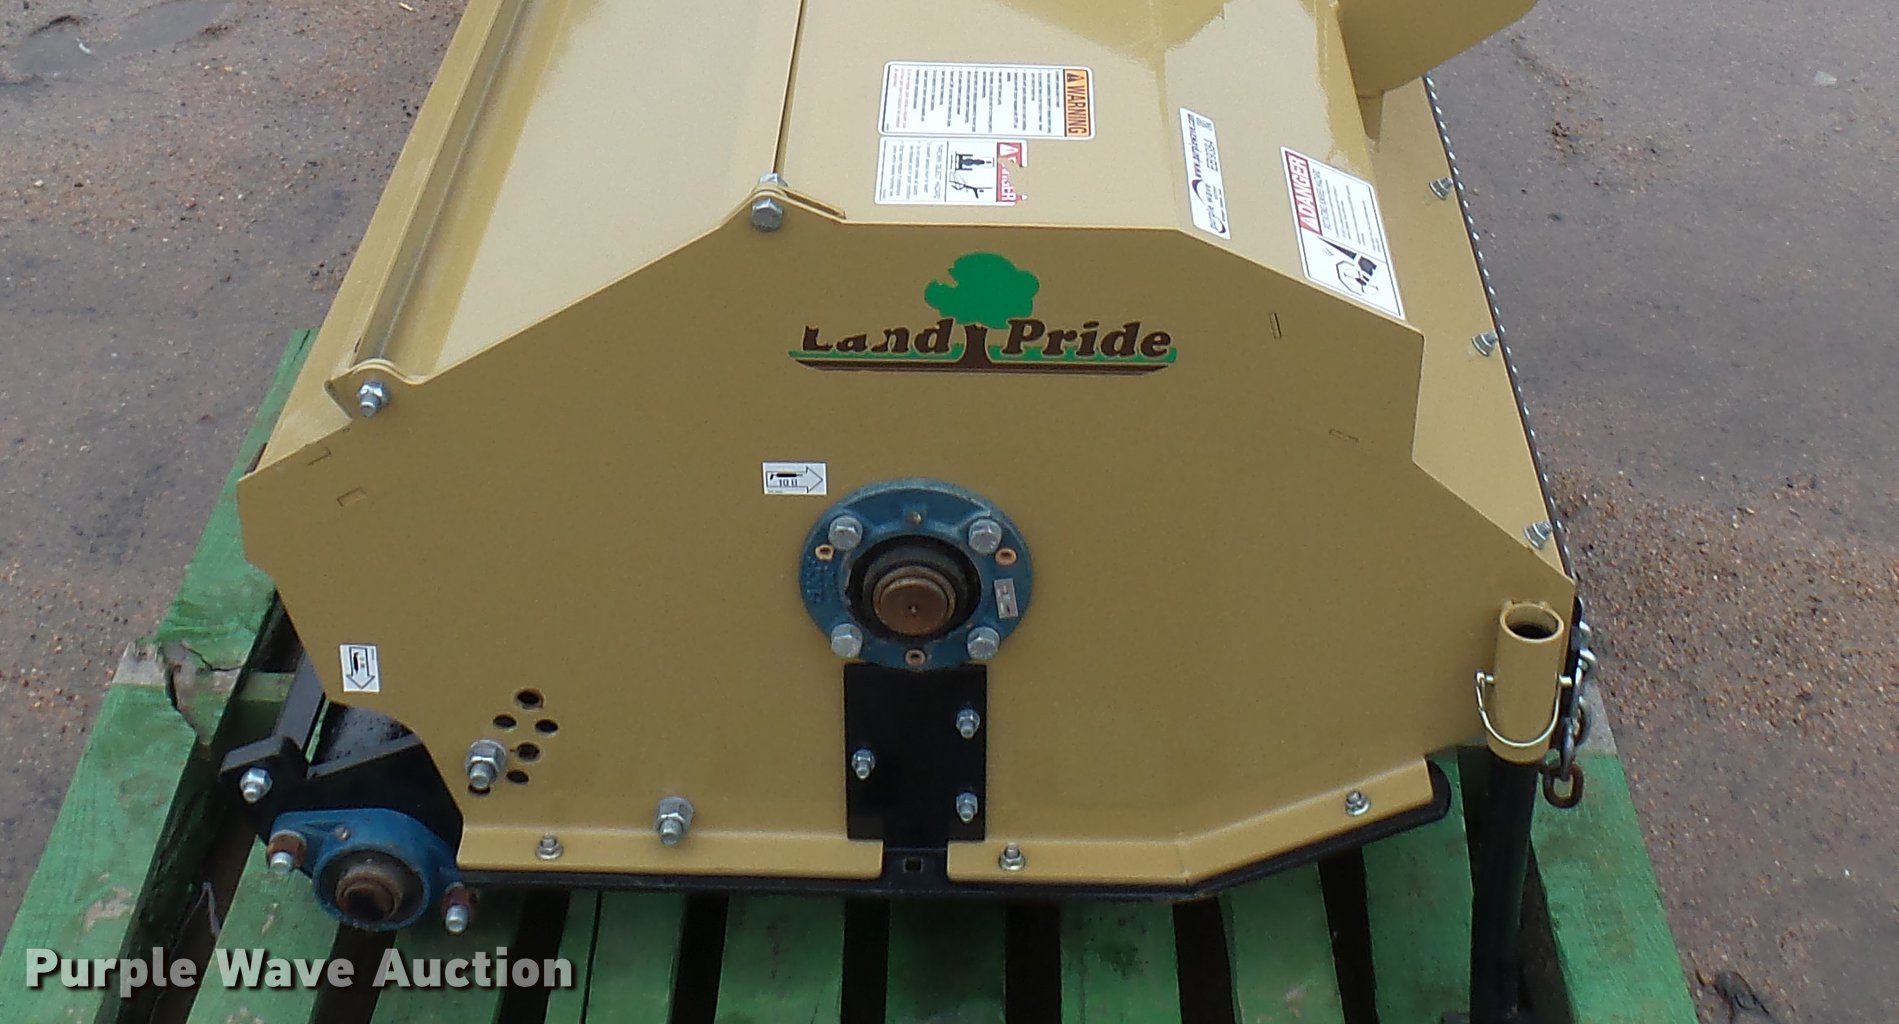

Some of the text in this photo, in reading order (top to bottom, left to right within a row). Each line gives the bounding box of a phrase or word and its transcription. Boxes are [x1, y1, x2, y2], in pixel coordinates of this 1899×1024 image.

[1067, 85, 1087, 134] WARNING
[1288, 158, 1316, 218] DANGER
[802, 318, 1172, 359] Land Pride
